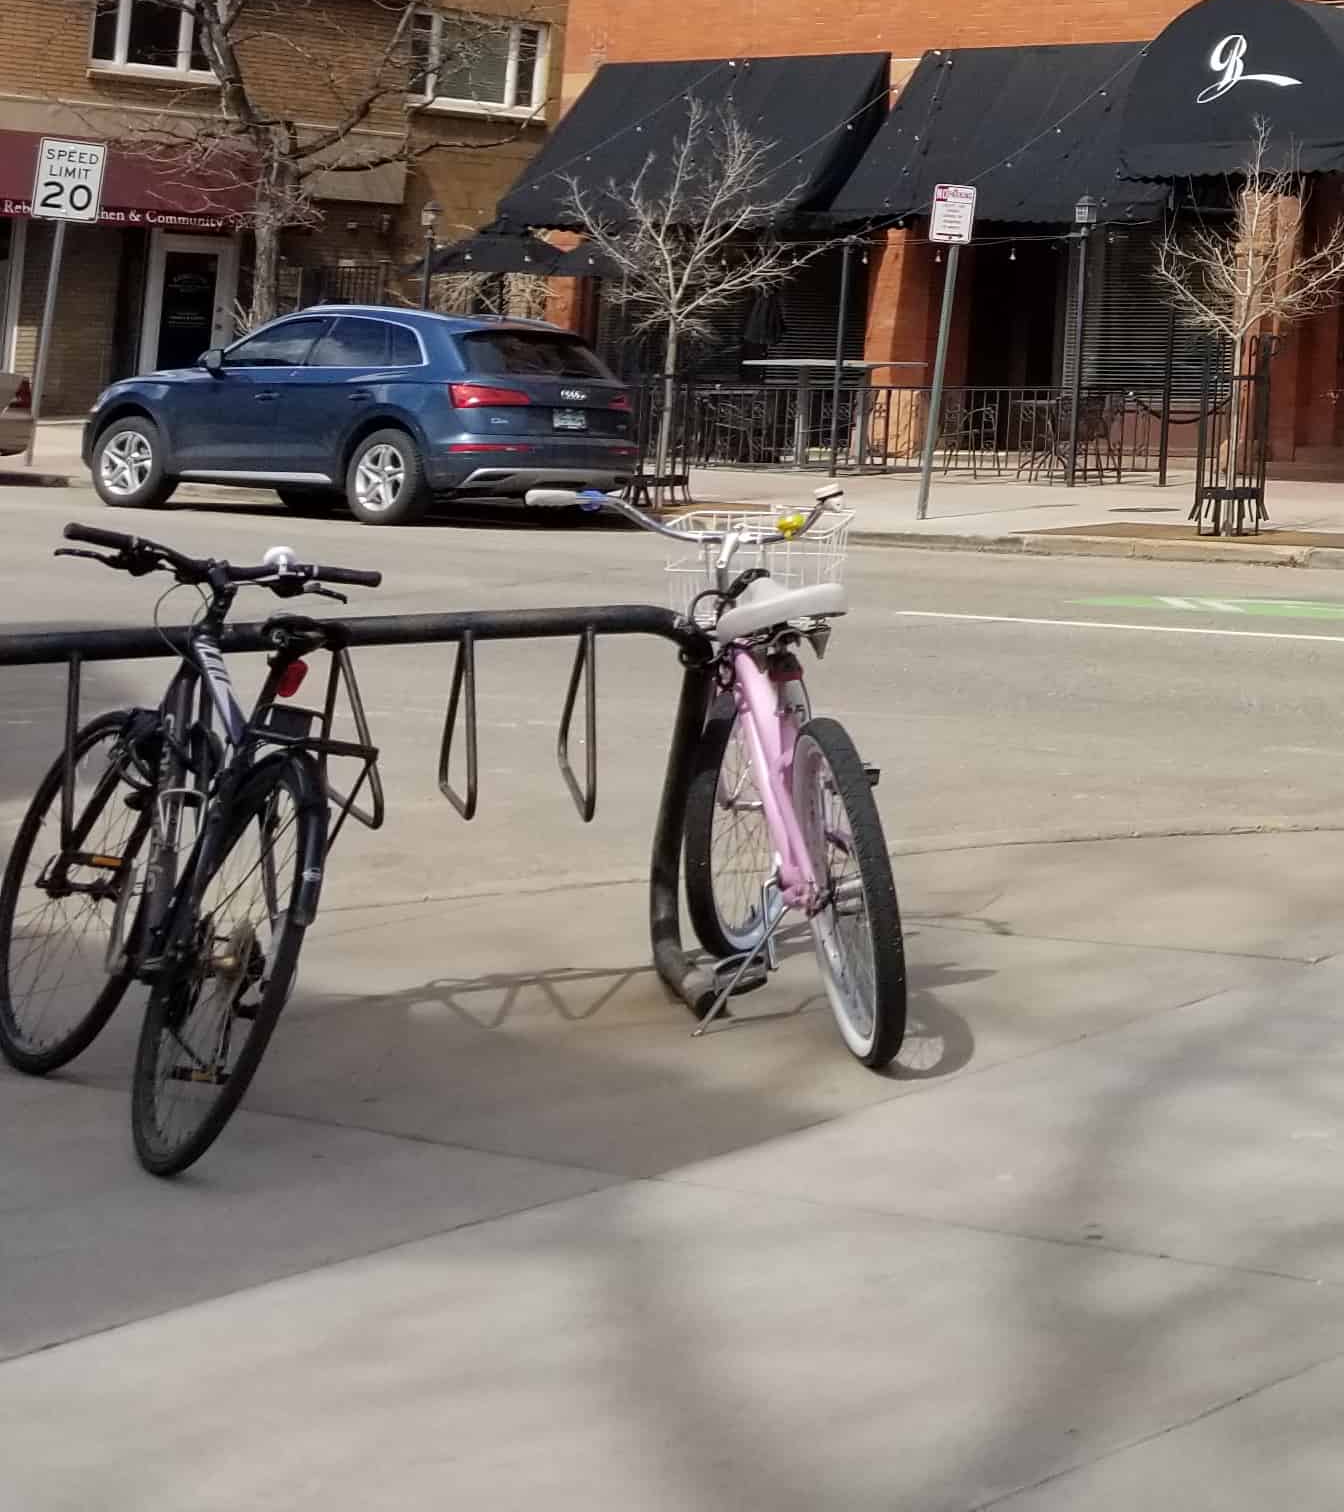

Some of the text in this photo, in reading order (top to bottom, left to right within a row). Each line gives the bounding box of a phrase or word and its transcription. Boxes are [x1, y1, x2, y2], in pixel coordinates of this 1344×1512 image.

[47, 148, 99, 165] SPEED
[48, 164, 92, 181] LIMIT
[40, 181, 92, 211] 20
[129, 211, 142, 223] &
[146, 212, 223, 228] Community
